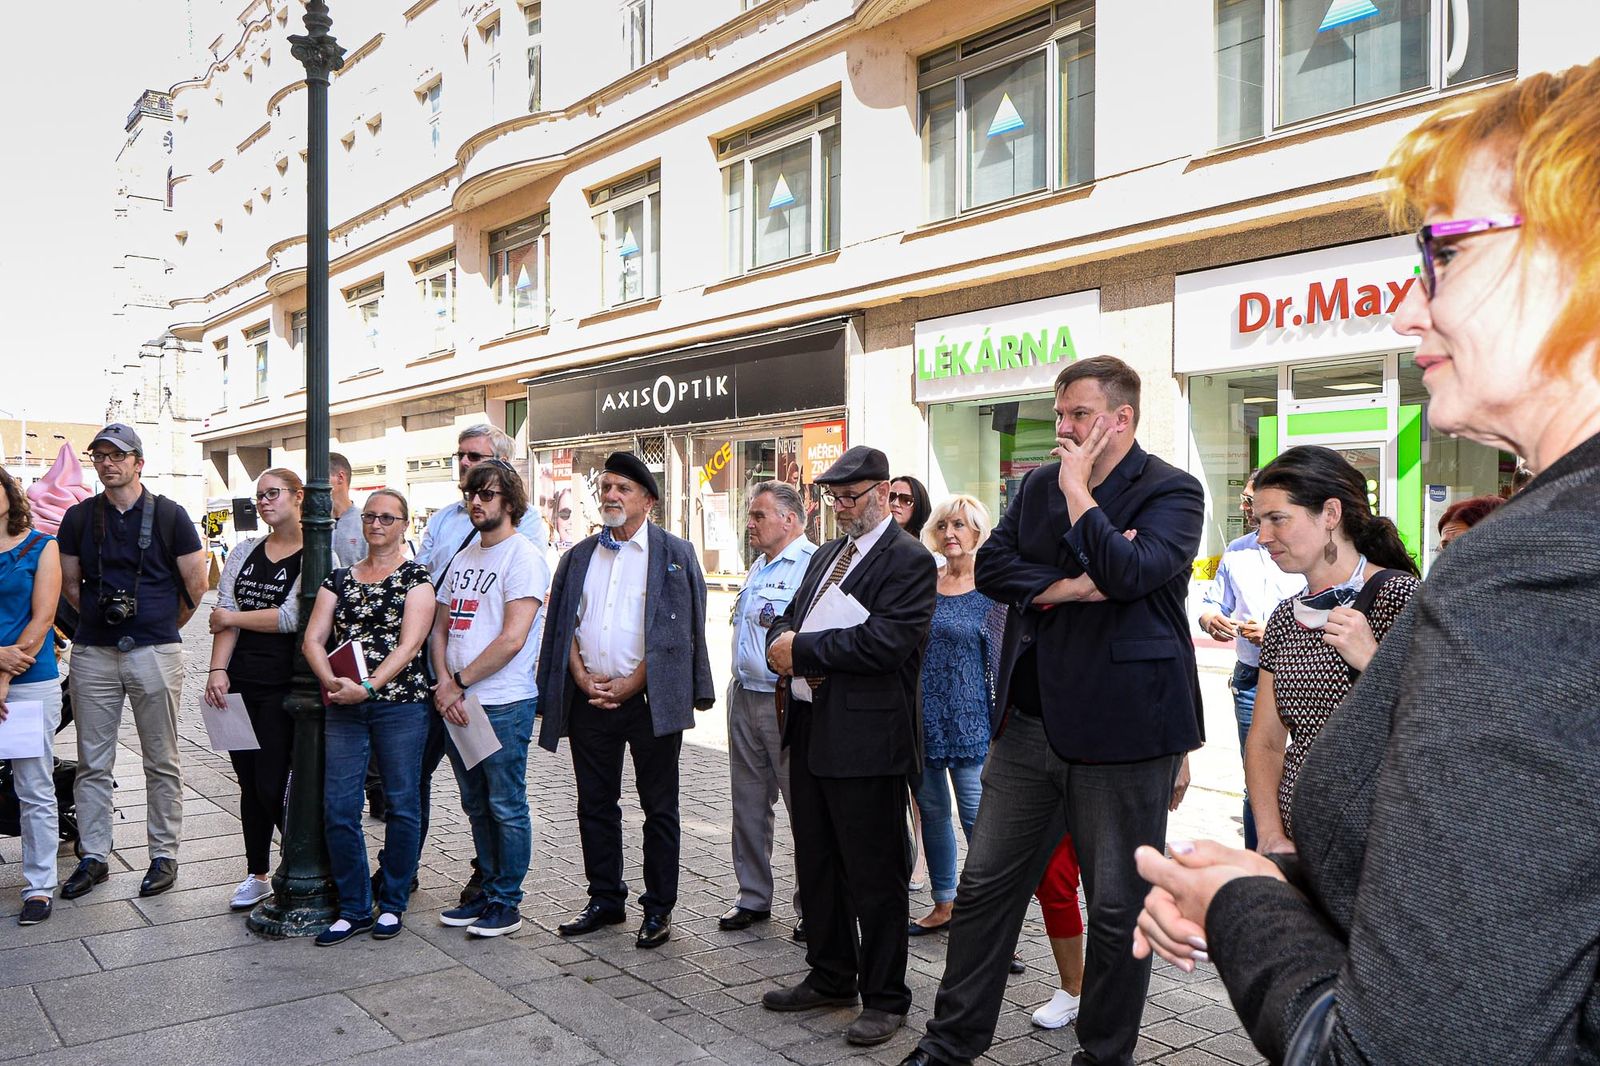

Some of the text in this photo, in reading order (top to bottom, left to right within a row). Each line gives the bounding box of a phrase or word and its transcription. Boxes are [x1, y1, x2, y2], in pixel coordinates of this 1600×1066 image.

[1239, 277, 1416, 333] Dr.Max
[917, 325, 1077, 381] LÉKÁRNA
[697, 441, 734, 488] AKCE
[246, 589, 261, 597] nine
[264, 584, 285, 592] spend
[255, 601, 268, 609] you
